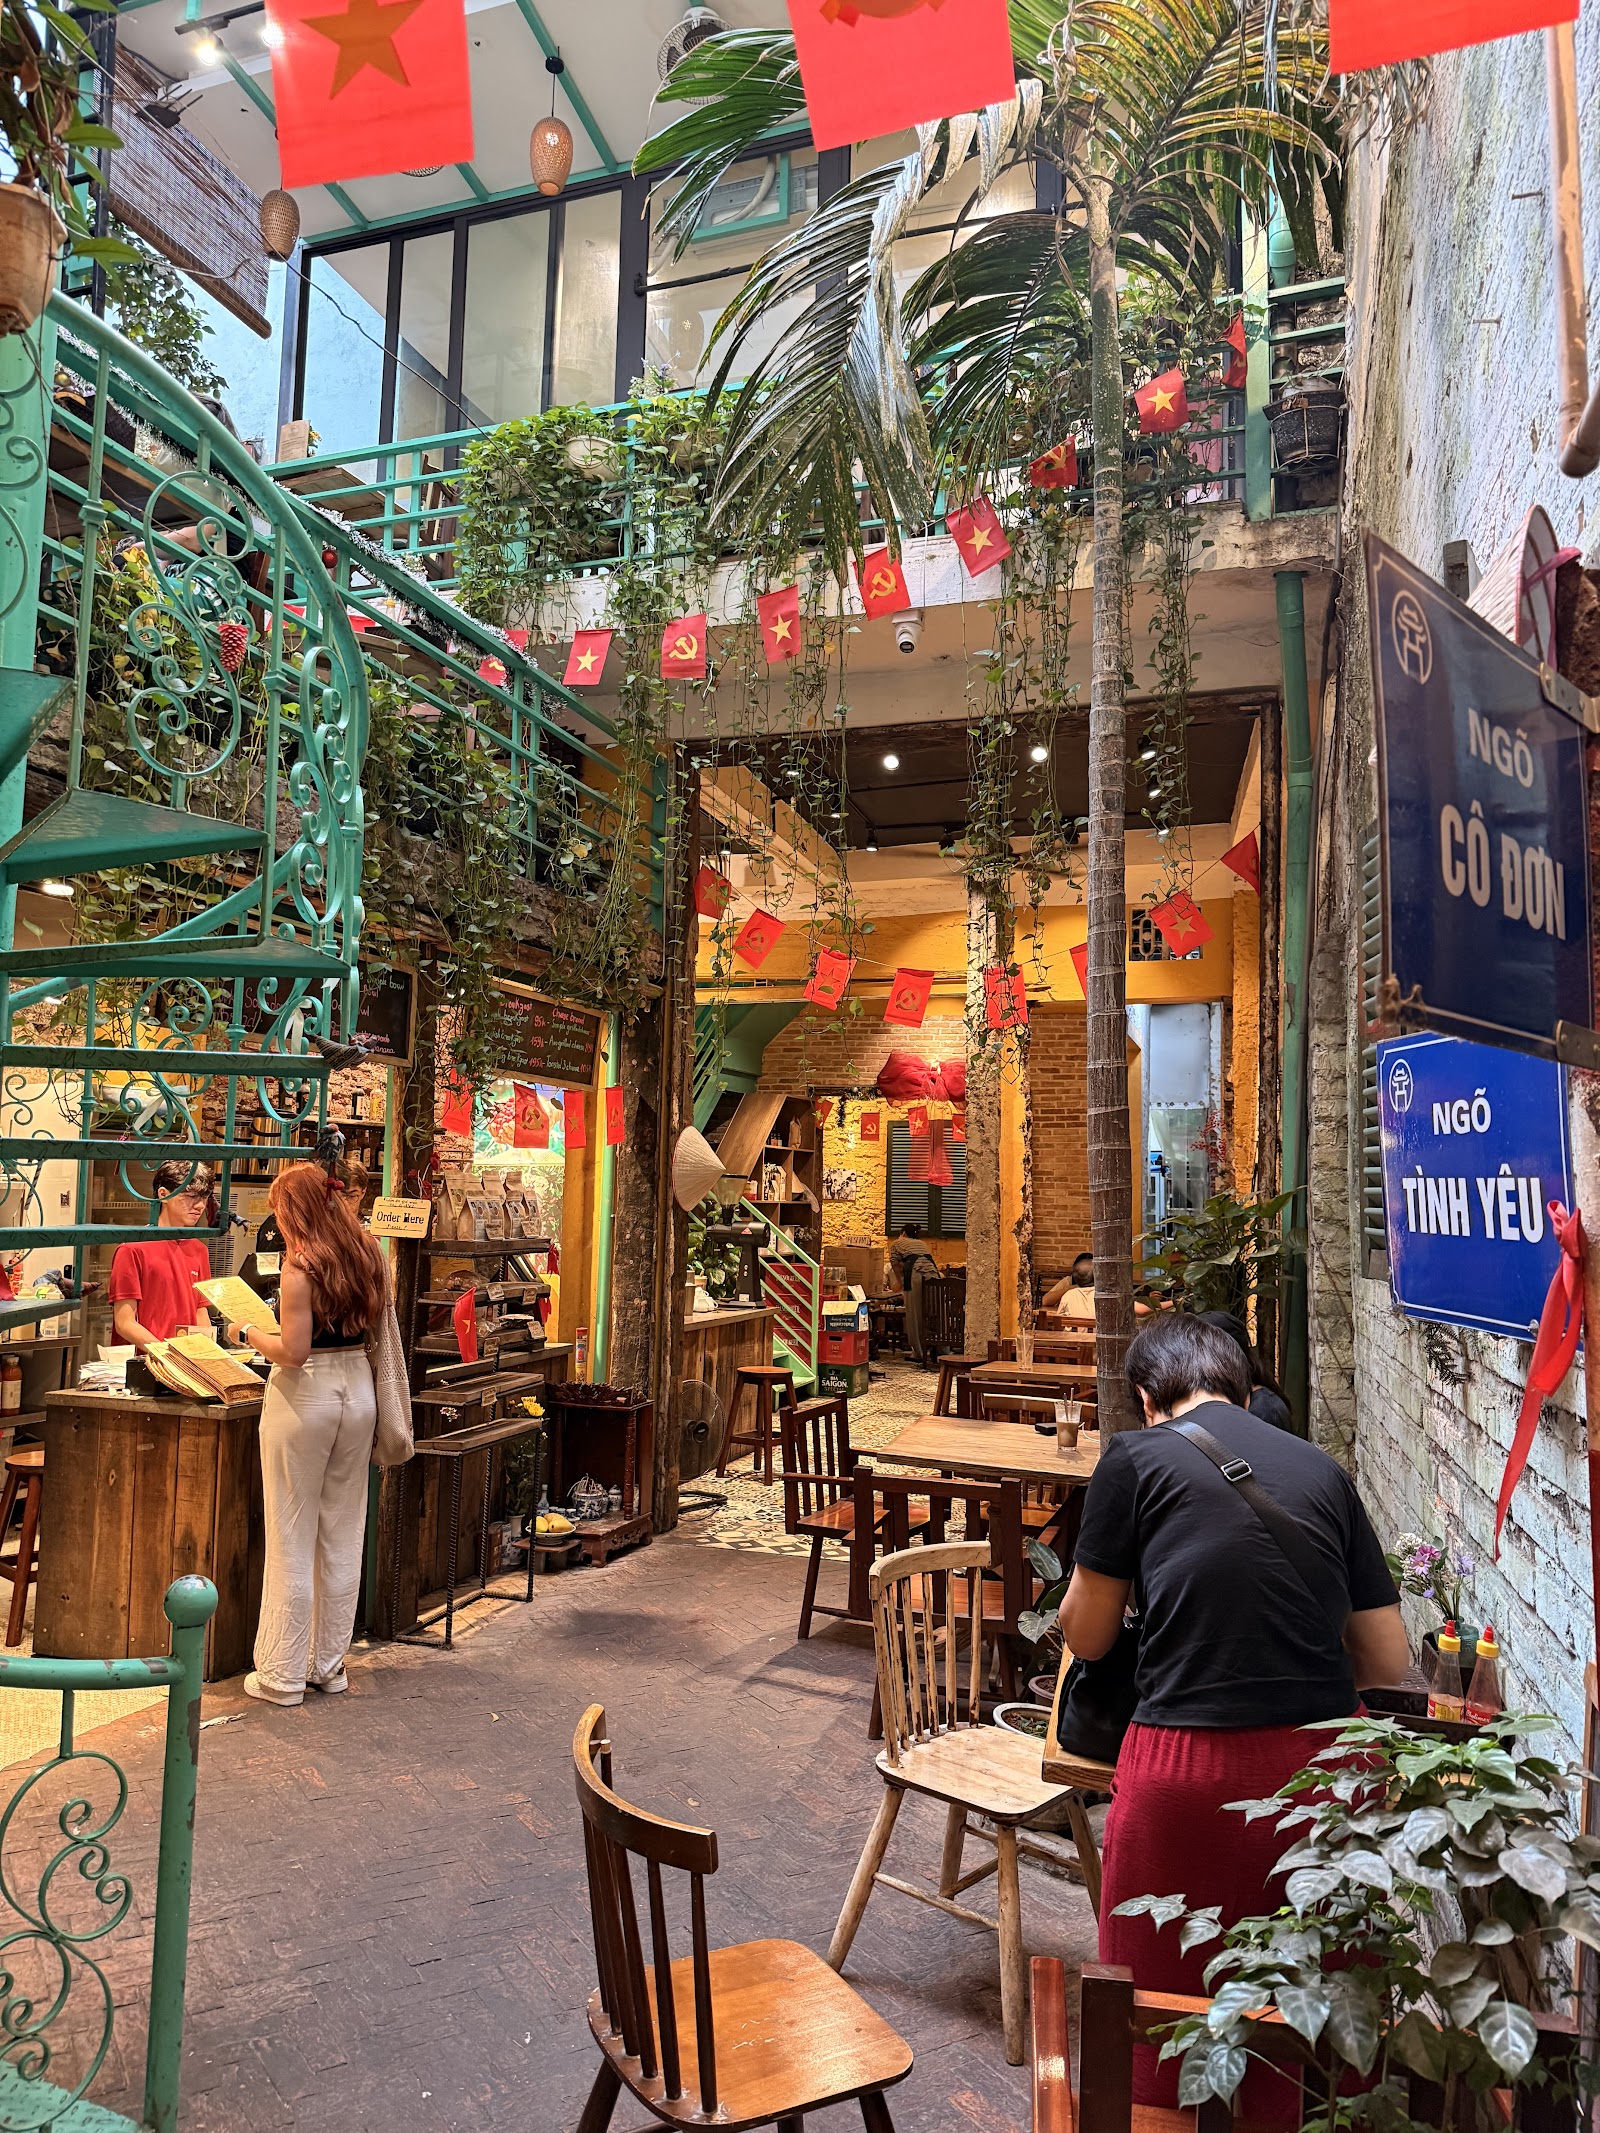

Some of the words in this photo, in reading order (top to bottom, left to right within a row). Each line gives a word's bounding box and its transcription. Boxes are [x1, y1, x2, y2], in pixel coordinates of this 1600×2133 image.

[1468, 707, 1534, 788] NGÕ
[1440, 799, 1491, 908] CÔ
[1501, 833, 1566, 940] ĐƠN
[1432, 1087, 1492, 1135] NGÕ
[376, 1211, 401, 1222] Order
[403, 1213, 425, 1224] Here
[1402, 1165, 1470, 1237] TÌNH
[1476, 1163, 1544, 1244] YÊU
[821, 1379, 848, 1388] SAIGON
